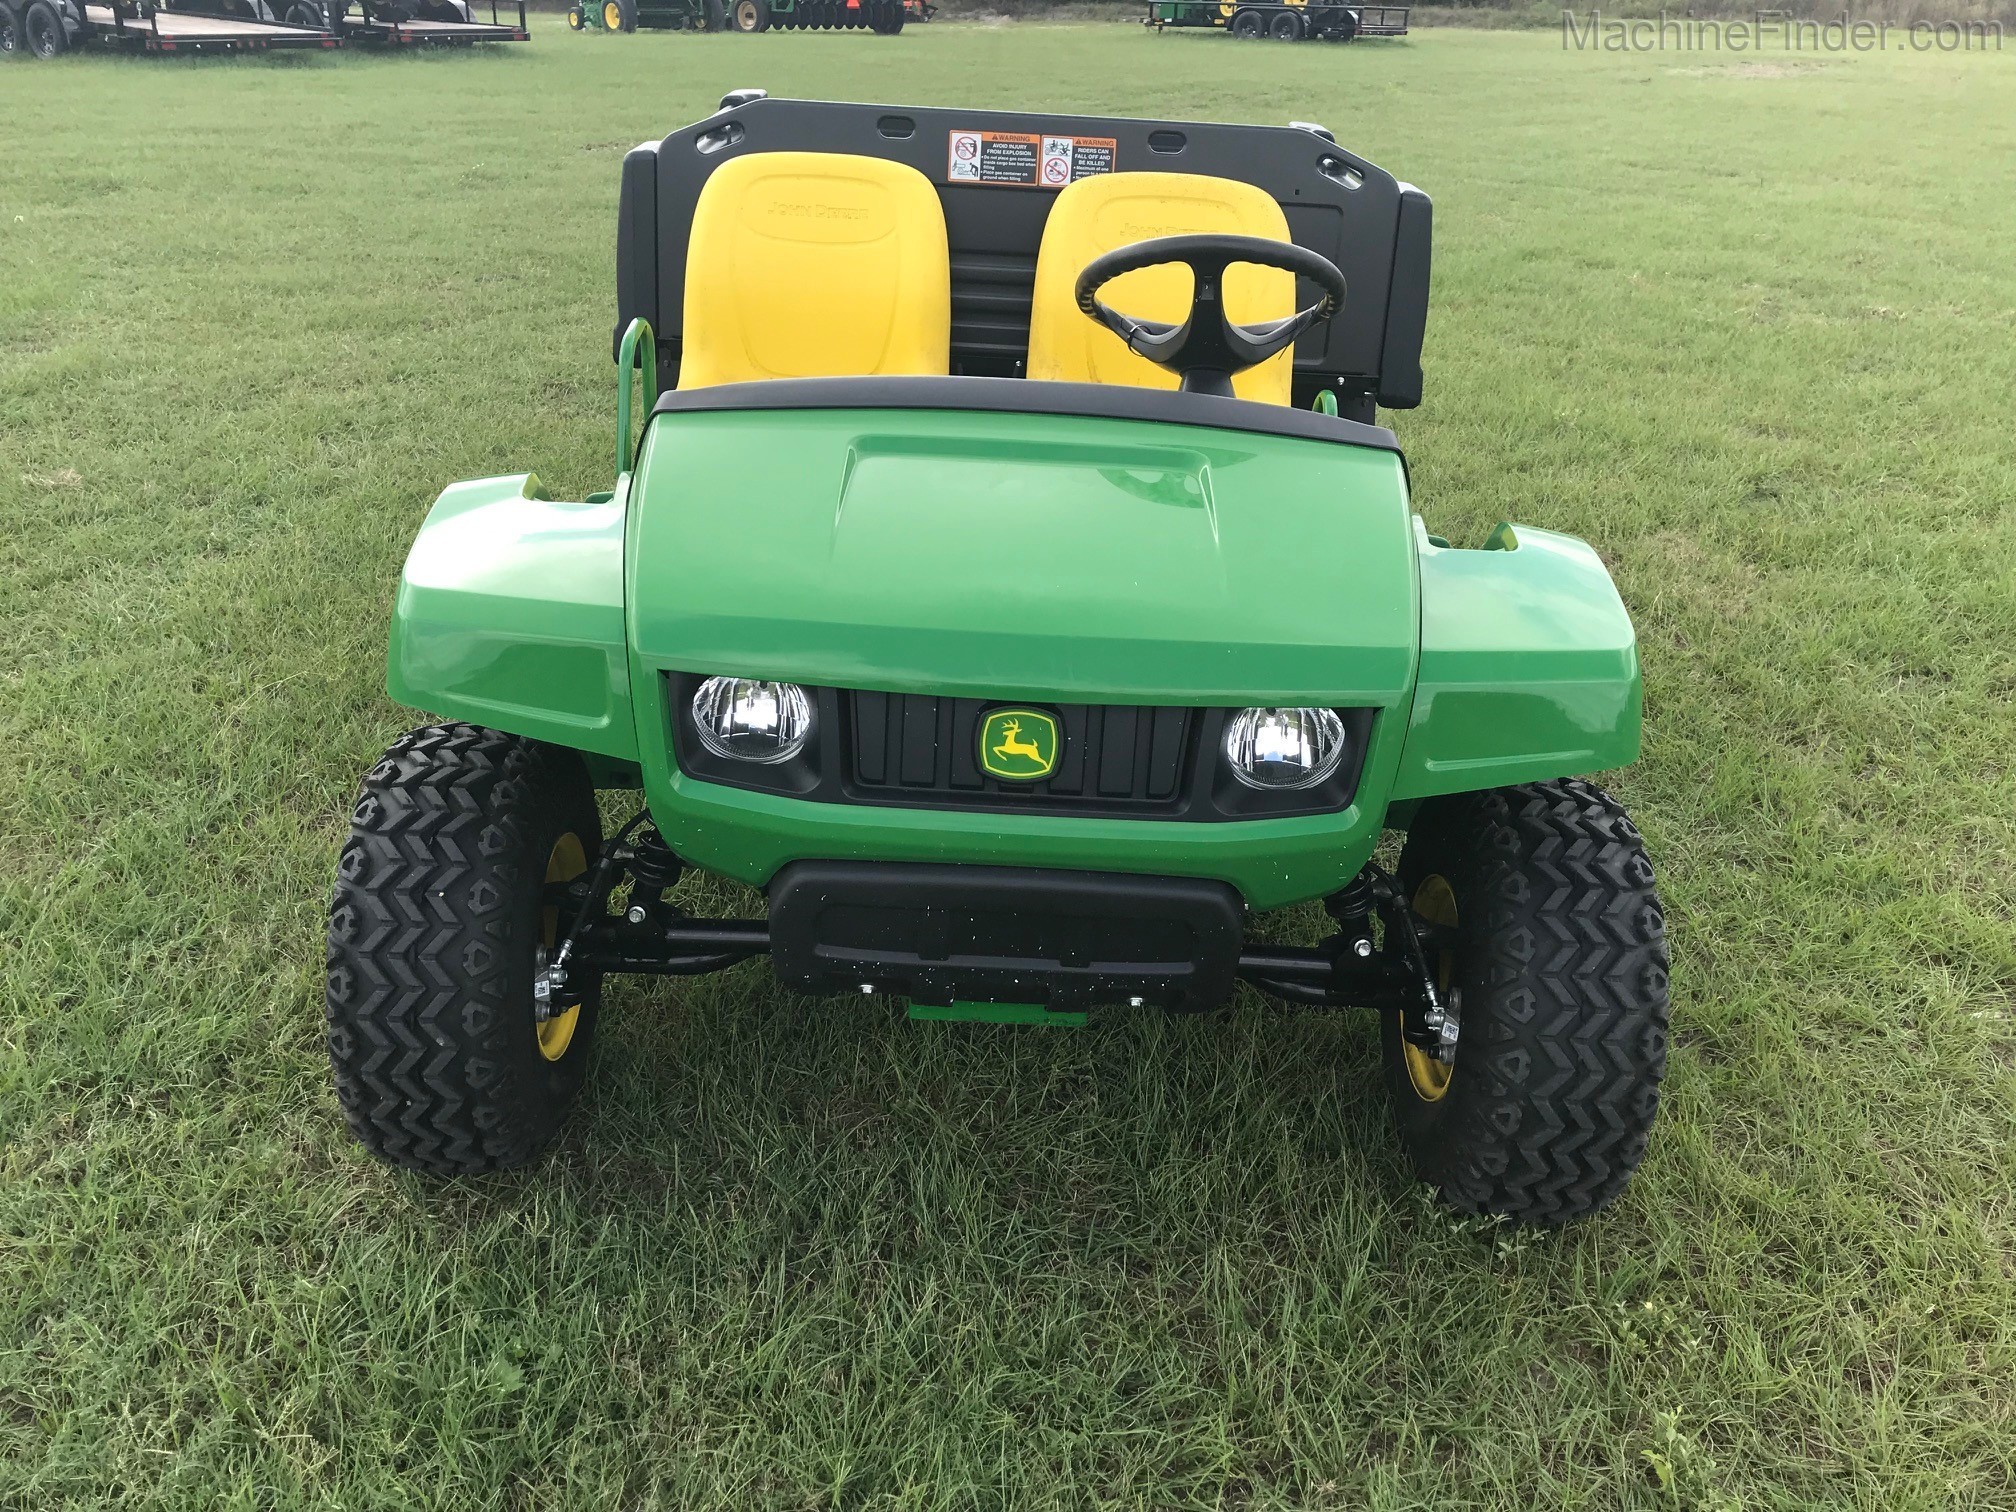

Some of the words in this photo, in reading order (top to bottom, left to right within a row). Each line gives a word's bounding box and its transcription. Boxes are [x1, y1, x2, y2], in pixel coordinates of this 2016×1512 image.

[768, 202, 812, 217] JOHN
[815, 204, 869, 220] DEERE
[1120, 223, 1163, 239] JOHN
